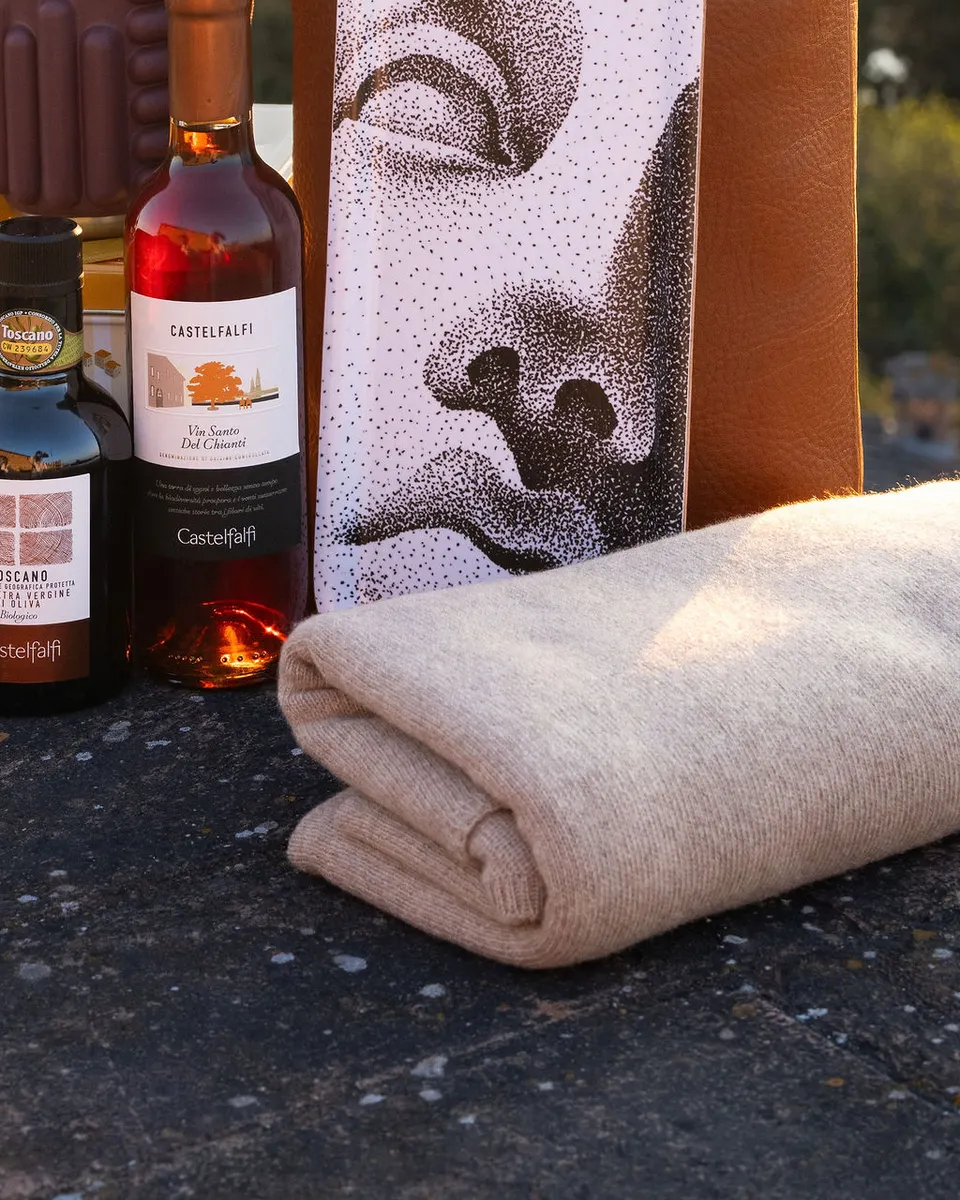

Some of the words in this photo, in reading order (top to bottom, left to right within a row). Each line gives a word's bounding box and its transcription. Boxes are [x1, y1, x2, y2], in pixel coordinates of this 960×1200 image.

[1, 324, 54, 341] Toscano
[170, 322, 253, 338] CASTELFALFI
[14, 345, 49, 353] 239684
[188, 425, 206, 437] Vin
[208, 425, 240, 437] Santo
[181, 437, 200, 450] Del
[203, 437, 247, 450] Chianti
[177, 525, 256, 549] Castelfalfi
[4, 583, 43, 591] GEOGRAFICA
[45, 580, 76, 589] PROTETTA
[26, 589, 71, 600] VERGINE
[10, 599, 41, 608] OLIVA
[0, 610, 38, 623] Biologico
